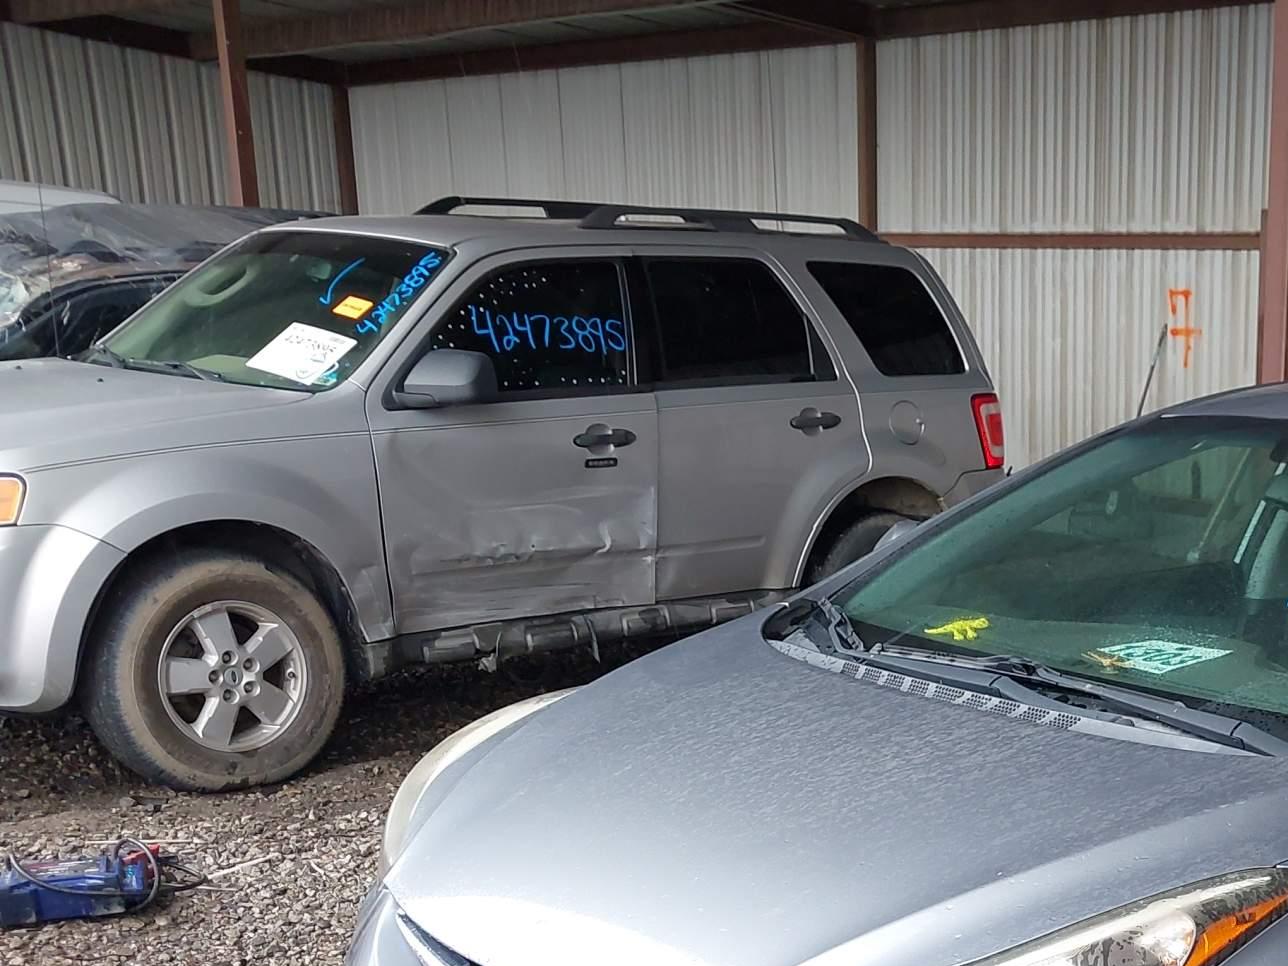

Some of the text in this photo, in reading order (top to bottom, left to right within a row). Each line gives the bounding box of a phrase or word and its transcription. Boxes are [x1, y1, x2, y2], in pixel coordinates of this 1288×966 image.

[356, 251, 442, 334] 42473895
[470, 304, 626, 355] 42473895
[1167, 287, 1202, 369] 7
